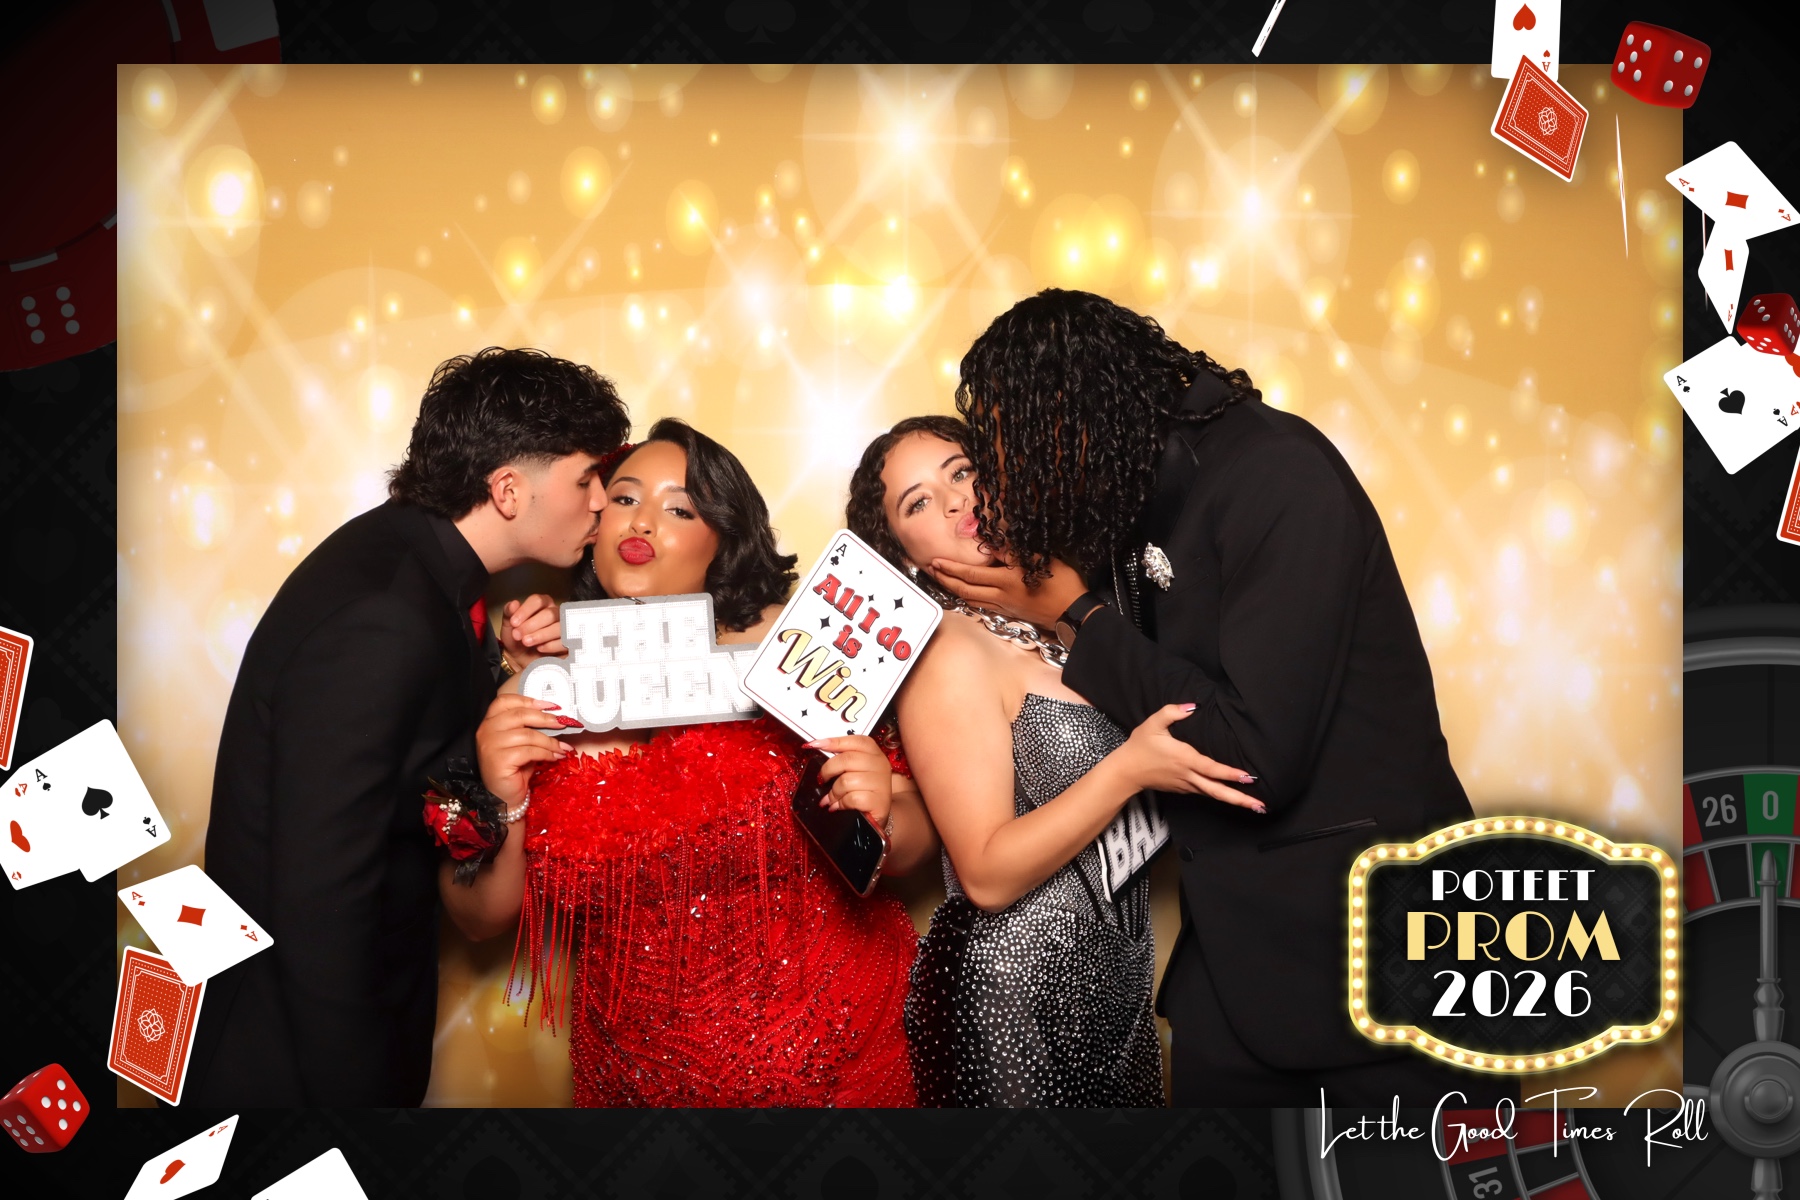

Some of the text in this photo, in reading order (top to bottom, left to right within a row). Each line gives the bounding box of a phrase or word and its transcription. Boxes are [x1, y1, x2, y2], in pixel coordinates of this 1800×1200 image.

[835, 543, 848, 557] A
[565, 600, 712, 664] THE
[812, 573, 912, 661] All I do
[832, 624, 863, 659] is
[776, 628, 868, 723] Win
